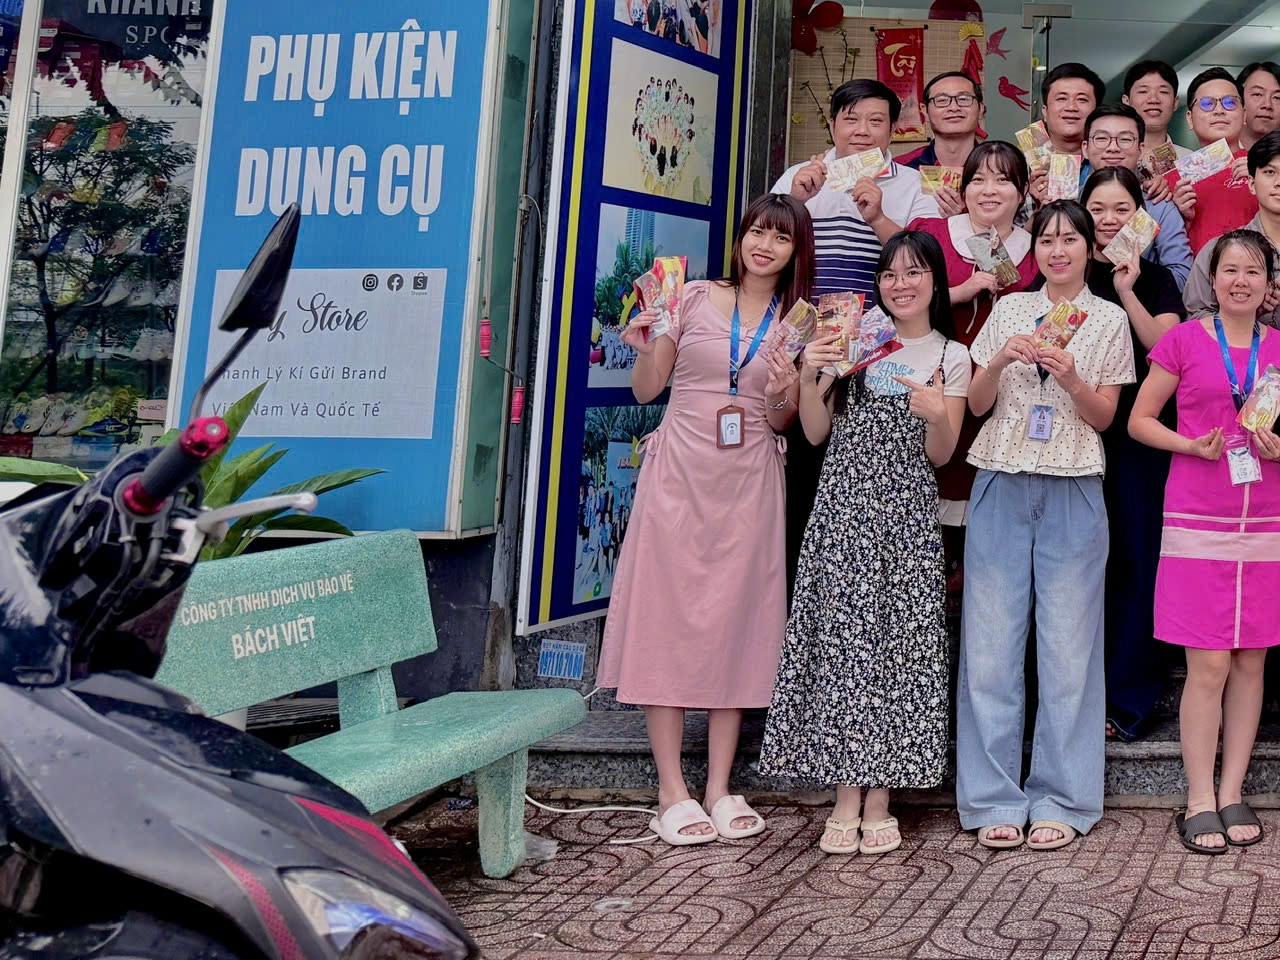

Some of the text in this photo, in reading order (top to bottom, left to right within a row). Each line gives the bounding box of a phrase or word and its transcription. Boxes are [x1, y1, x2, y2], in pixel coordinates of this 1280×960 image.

[243, 19, 458, 117] PHỤ KIỆN
[378, 144, 444, 232] CỤ
[297, 292, 369, 334] Store
[267, 365, 387, 383] Lý Kí Gửi Brand
[291, 400, 381, 418] Và Quốc Tế
[181, 601, 217, 626] CÔNG
[220, 597, 234, 619] TY
[235, 591, 270, 614] TNHH
[231, 613, 316, 660] BÁCH VIỆT
